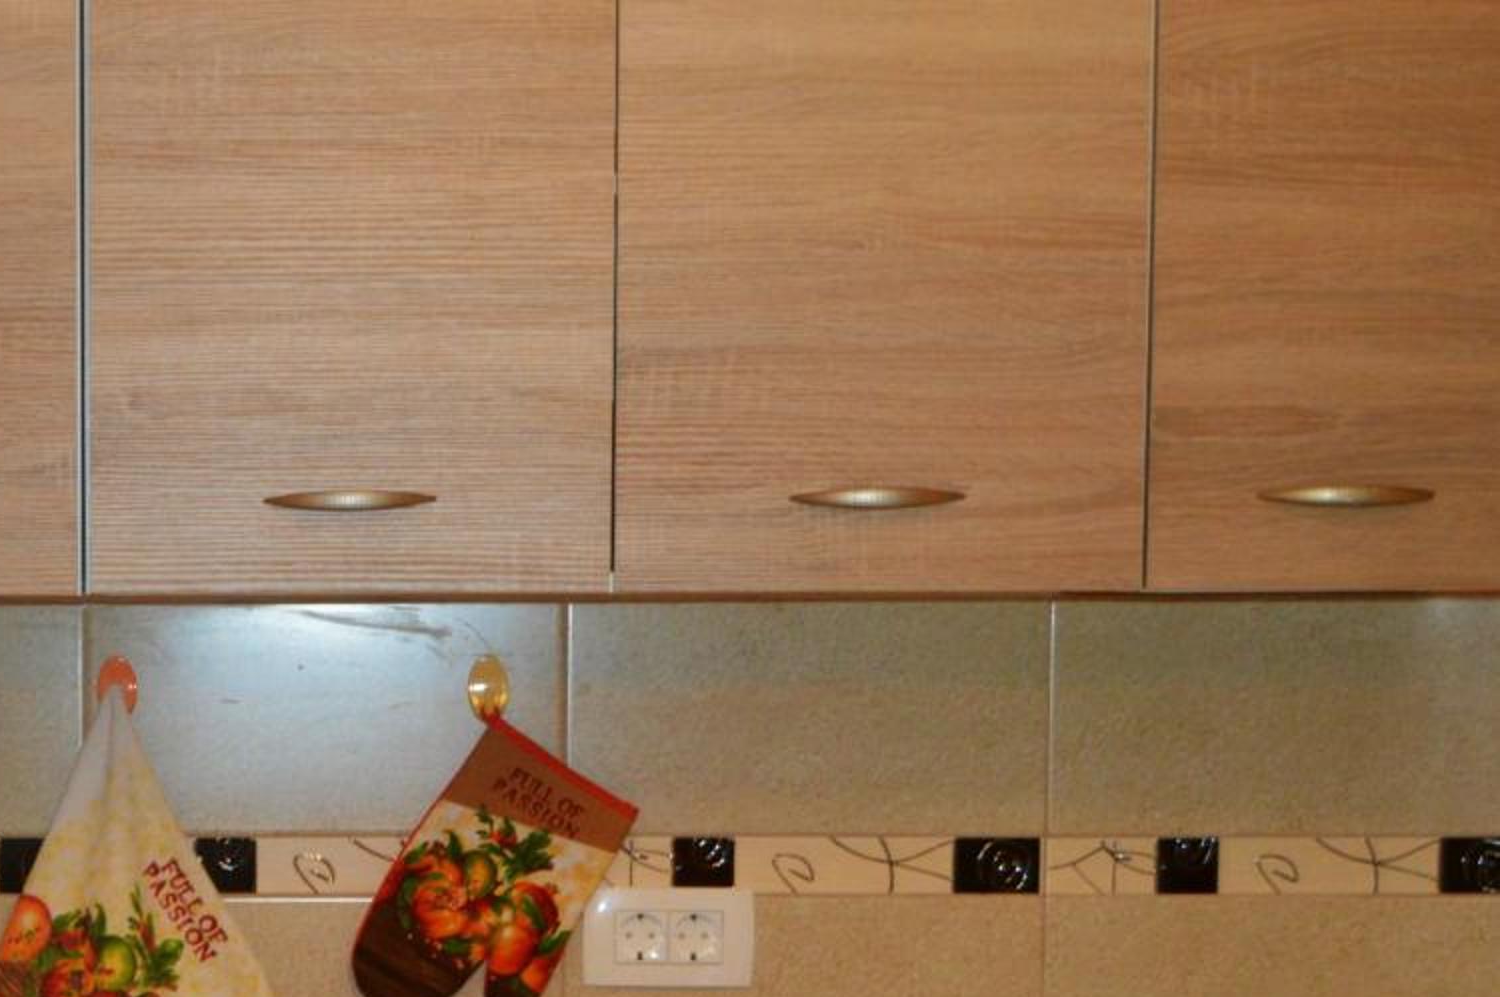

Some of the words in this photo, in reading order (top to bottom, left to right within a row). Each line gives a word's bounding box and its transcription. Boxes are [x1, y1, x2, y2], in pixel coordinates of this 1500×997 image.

[492, 778, 581, 839] PASSION
[509, 767, 553, 801] FULL
[558, 797, 584, 818] OF
[143, 861, 217, 962] PASSION
[162, 857, 203, 914] FULL
[199, 914, 228, 943] OF
